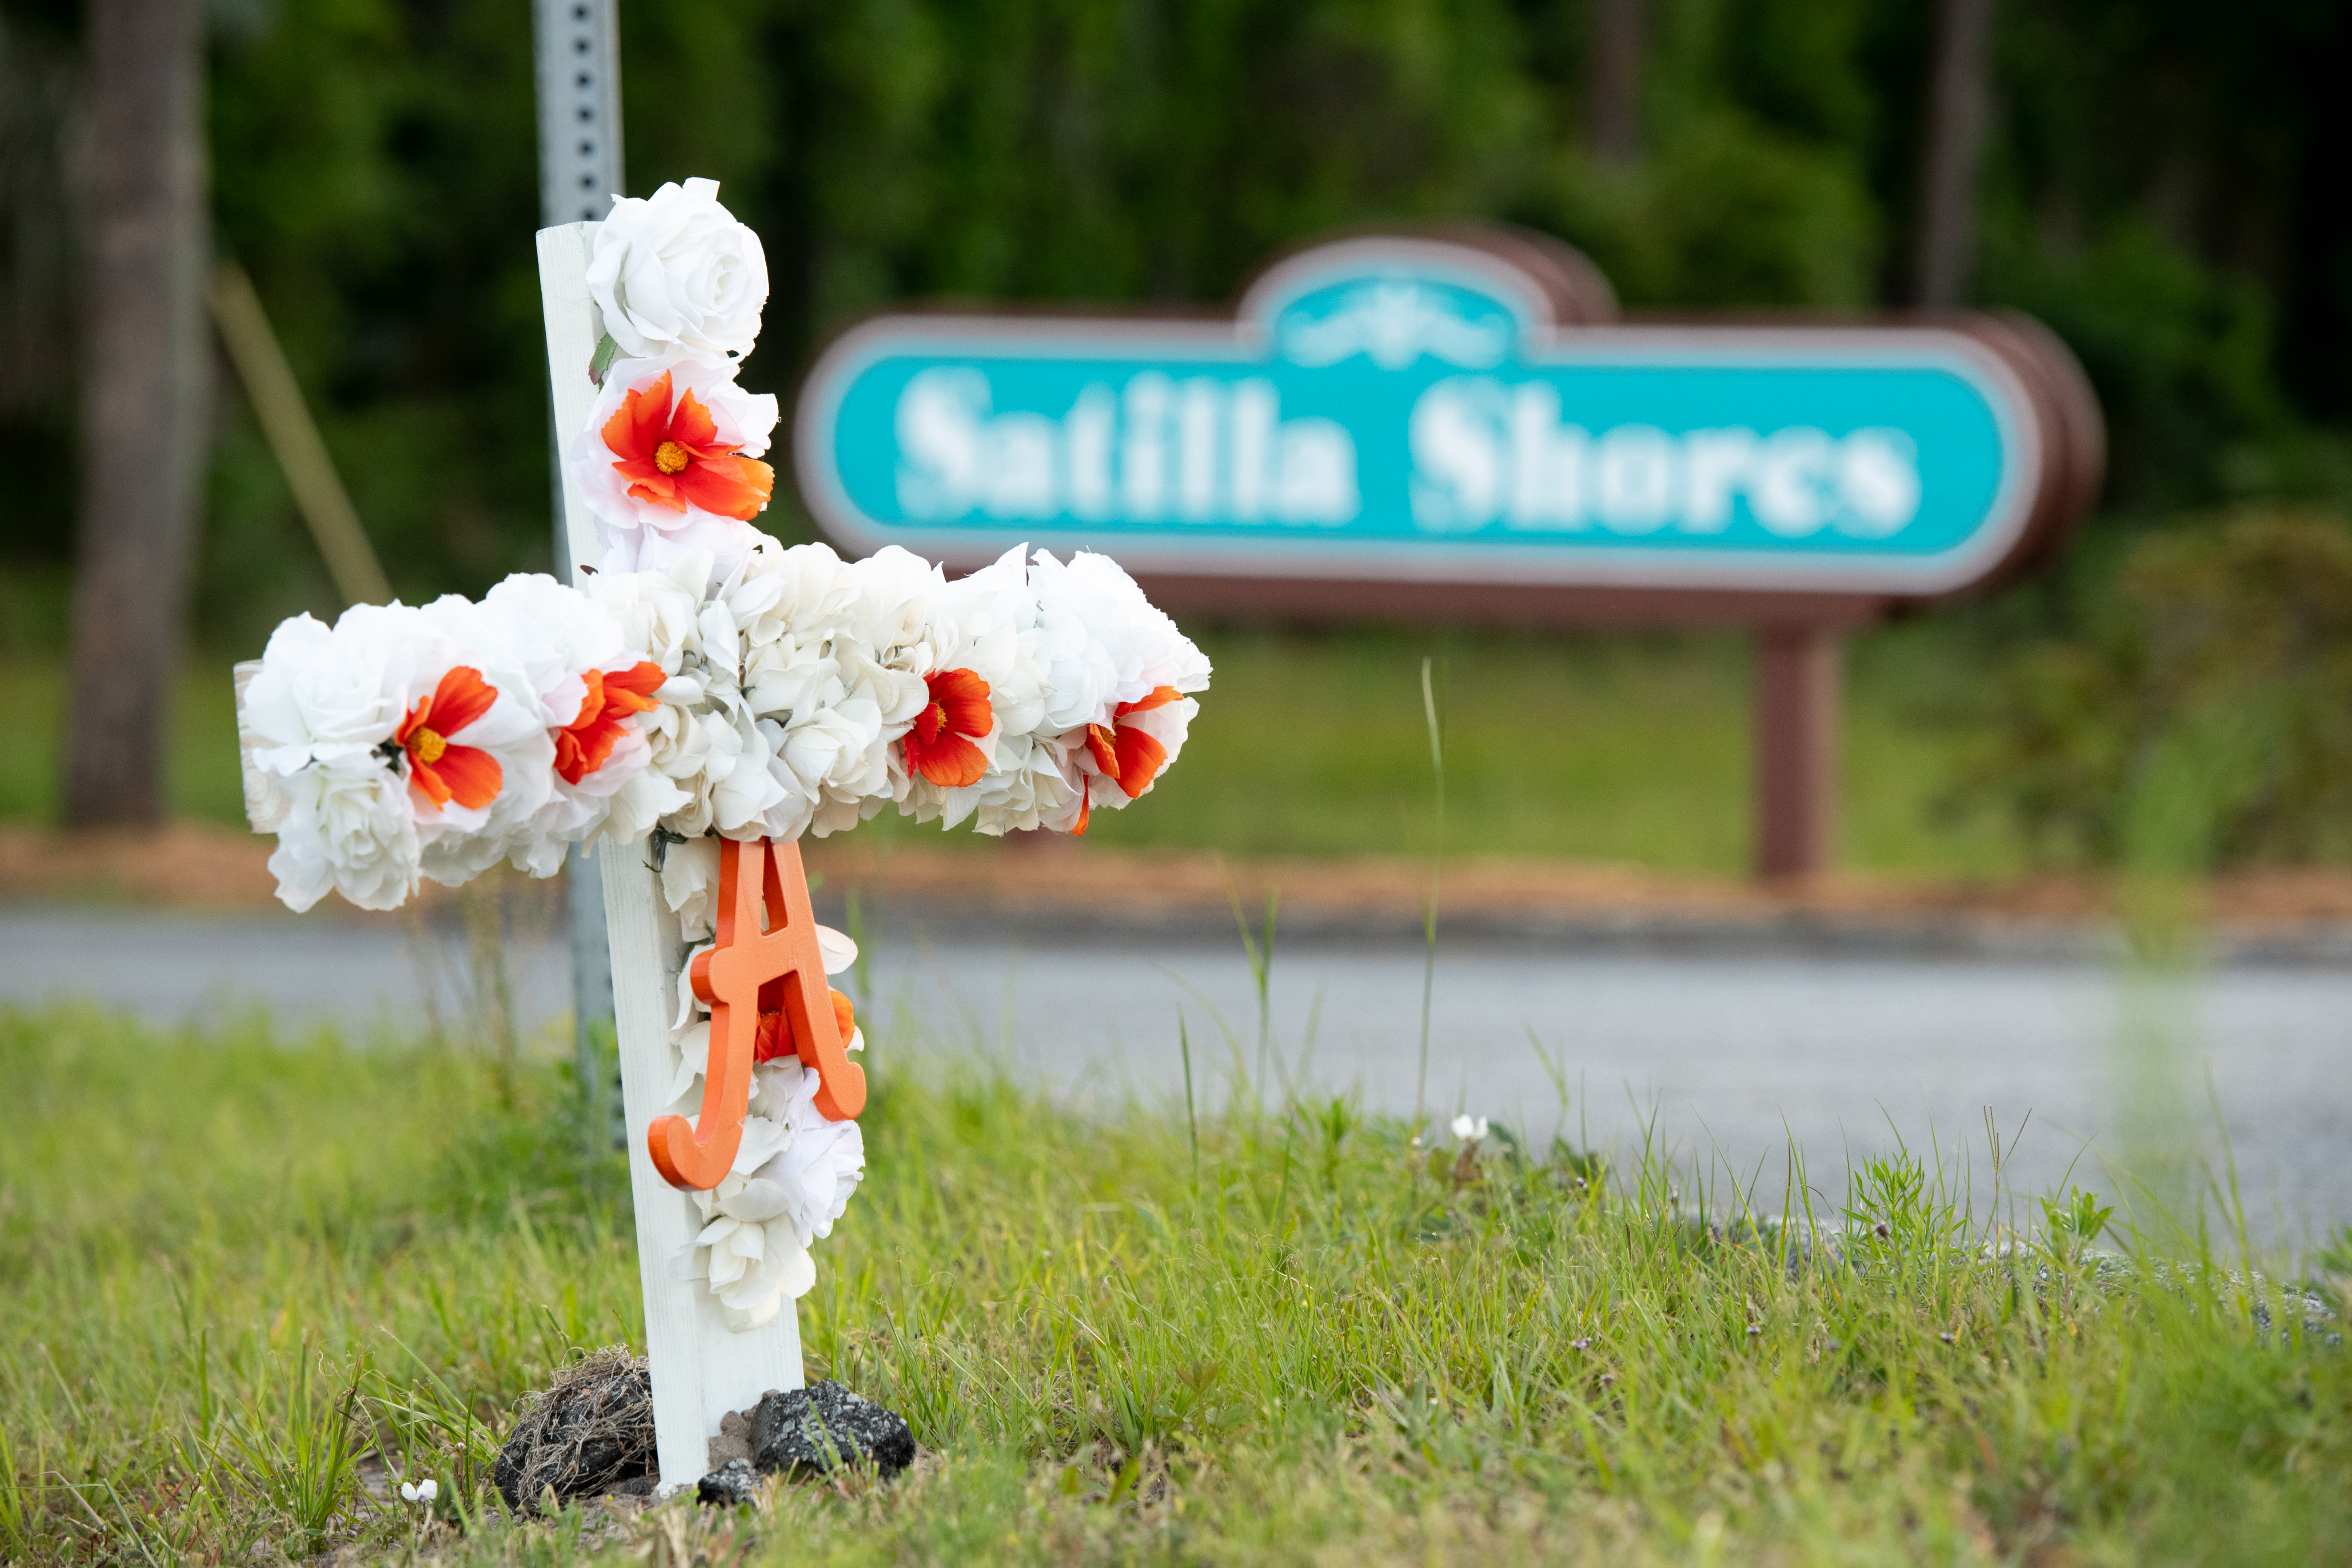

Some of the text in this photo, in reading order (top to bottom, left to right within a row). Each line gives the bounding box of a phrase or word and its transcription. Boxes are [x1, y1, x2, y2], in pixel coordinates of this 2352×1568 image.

[896, 368, 1918, 536] Satilla Shores
[648, 838, 866, 1190] A
